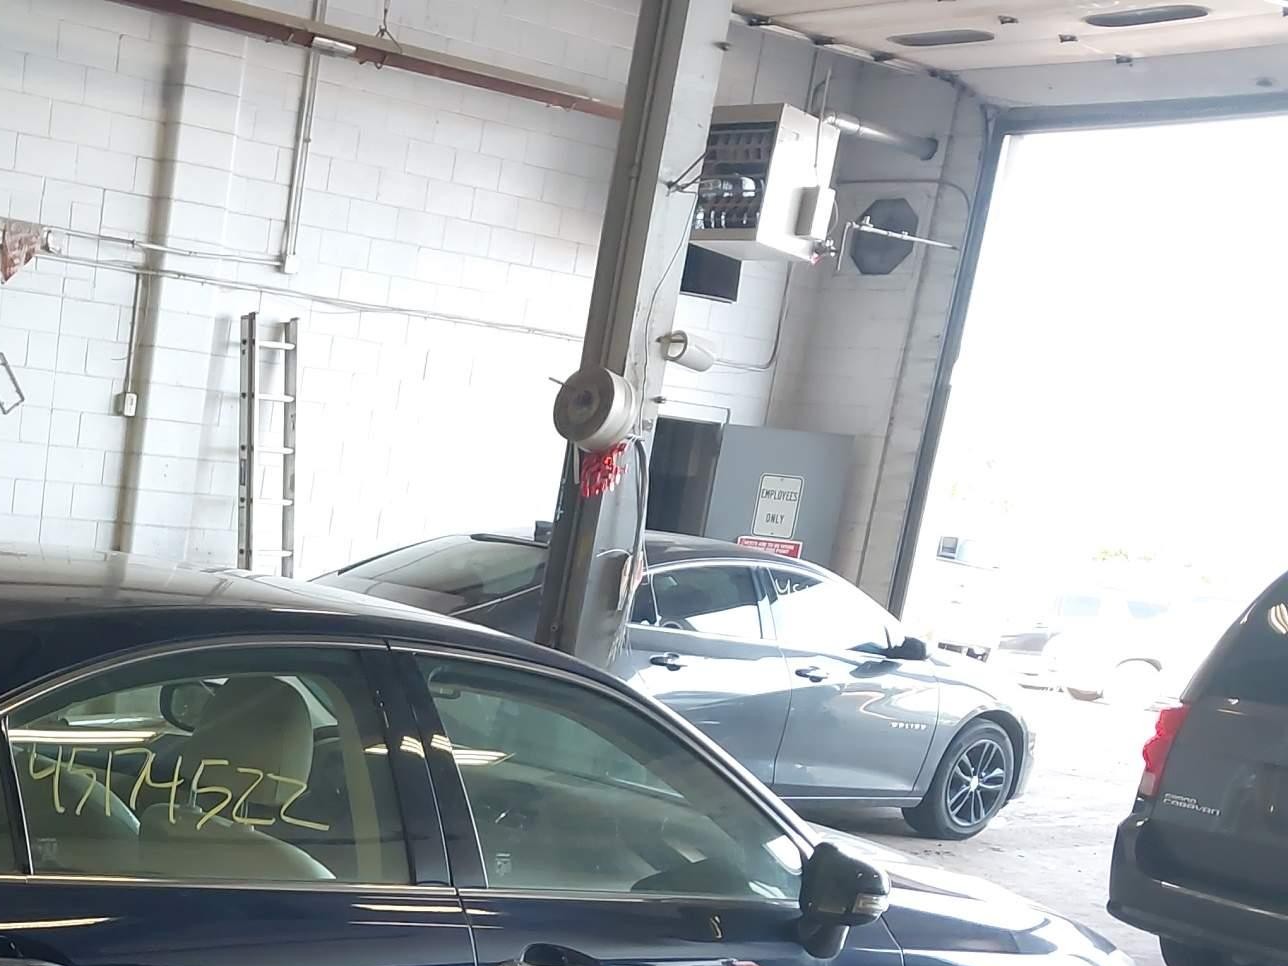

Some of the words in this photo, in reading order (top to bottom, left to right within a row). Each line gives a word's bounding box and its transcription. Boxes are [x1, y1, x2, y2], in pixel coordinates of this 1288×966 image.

[761, 488, 798, 502] EMPLOYEES
[766, 513, 784, 524] ONLY
[29, 743, 330, 830] 45174522
